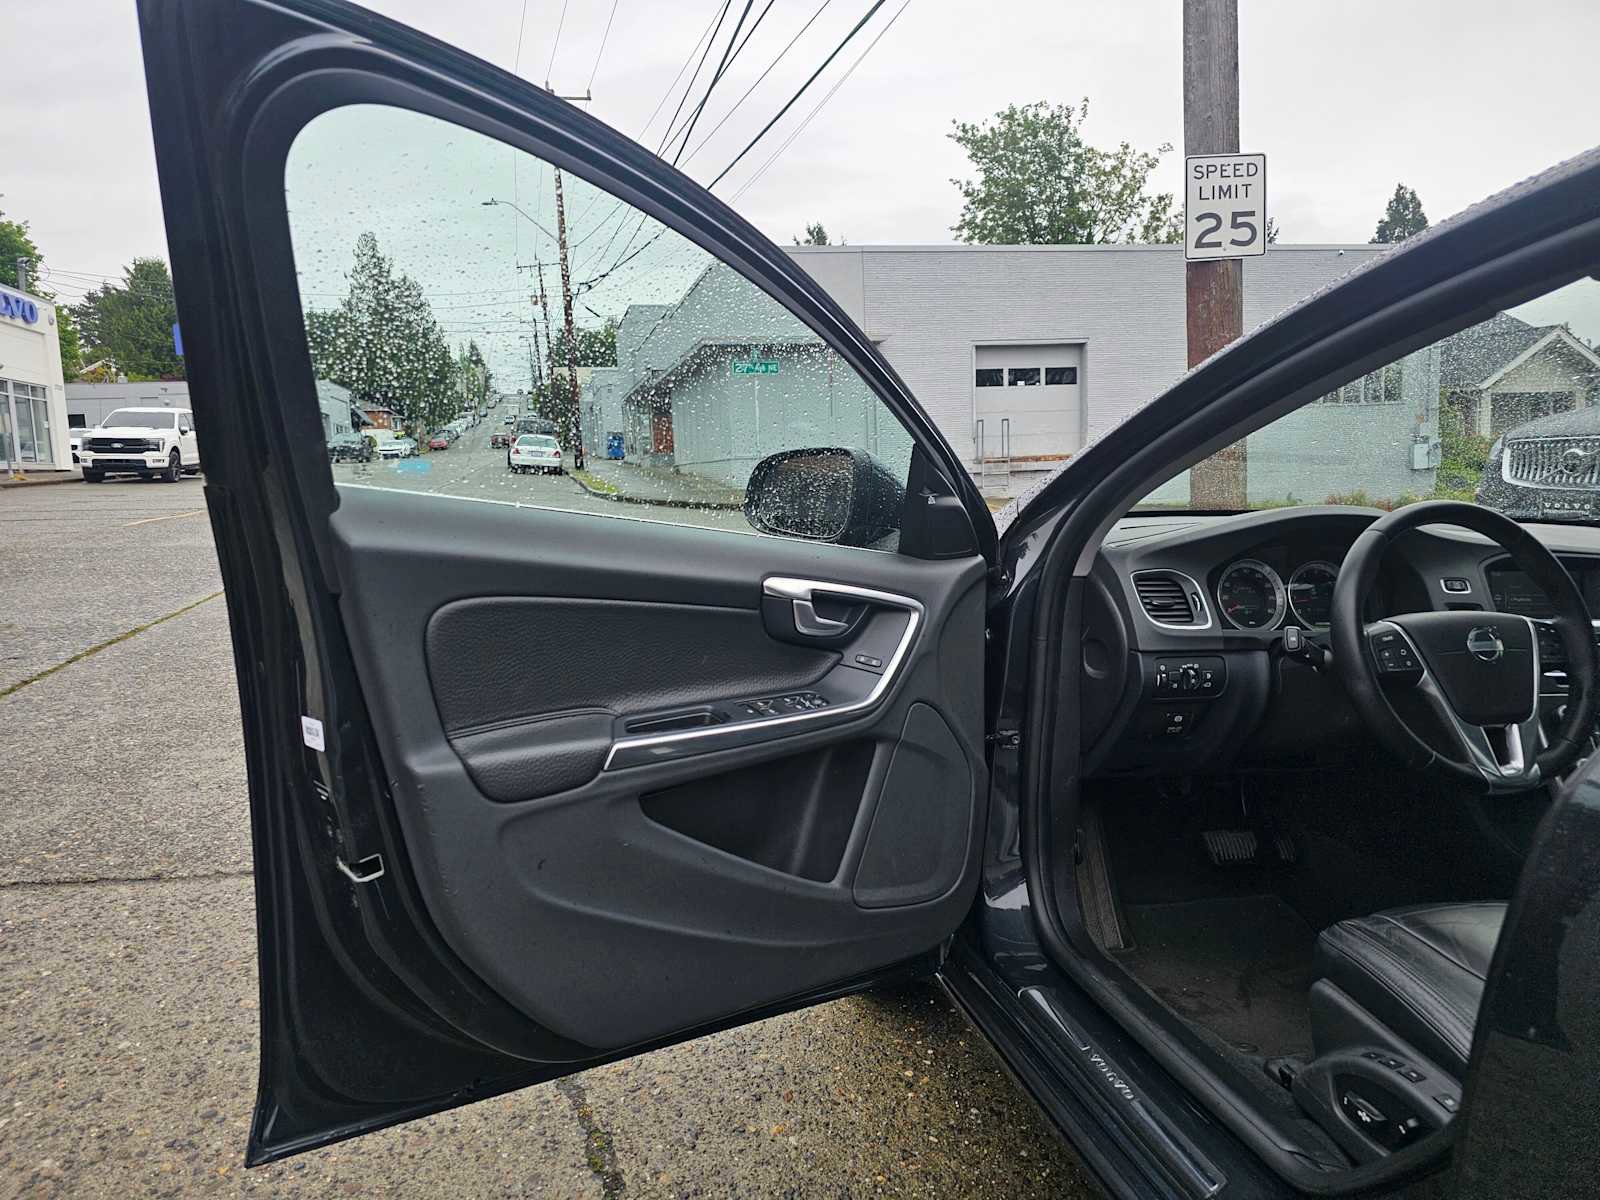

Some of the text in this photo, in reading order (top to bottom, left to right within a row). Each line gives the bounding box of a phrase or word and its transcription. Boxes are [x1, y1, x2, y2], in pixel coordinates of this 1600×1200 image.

[1193, 162, 1258, 180] SPEED
[1199, 183, 1252, 201] LIMIT
[1194, 211, 1258, 249] 25
[1090, 1053, 1135, 1100] VOLVO
